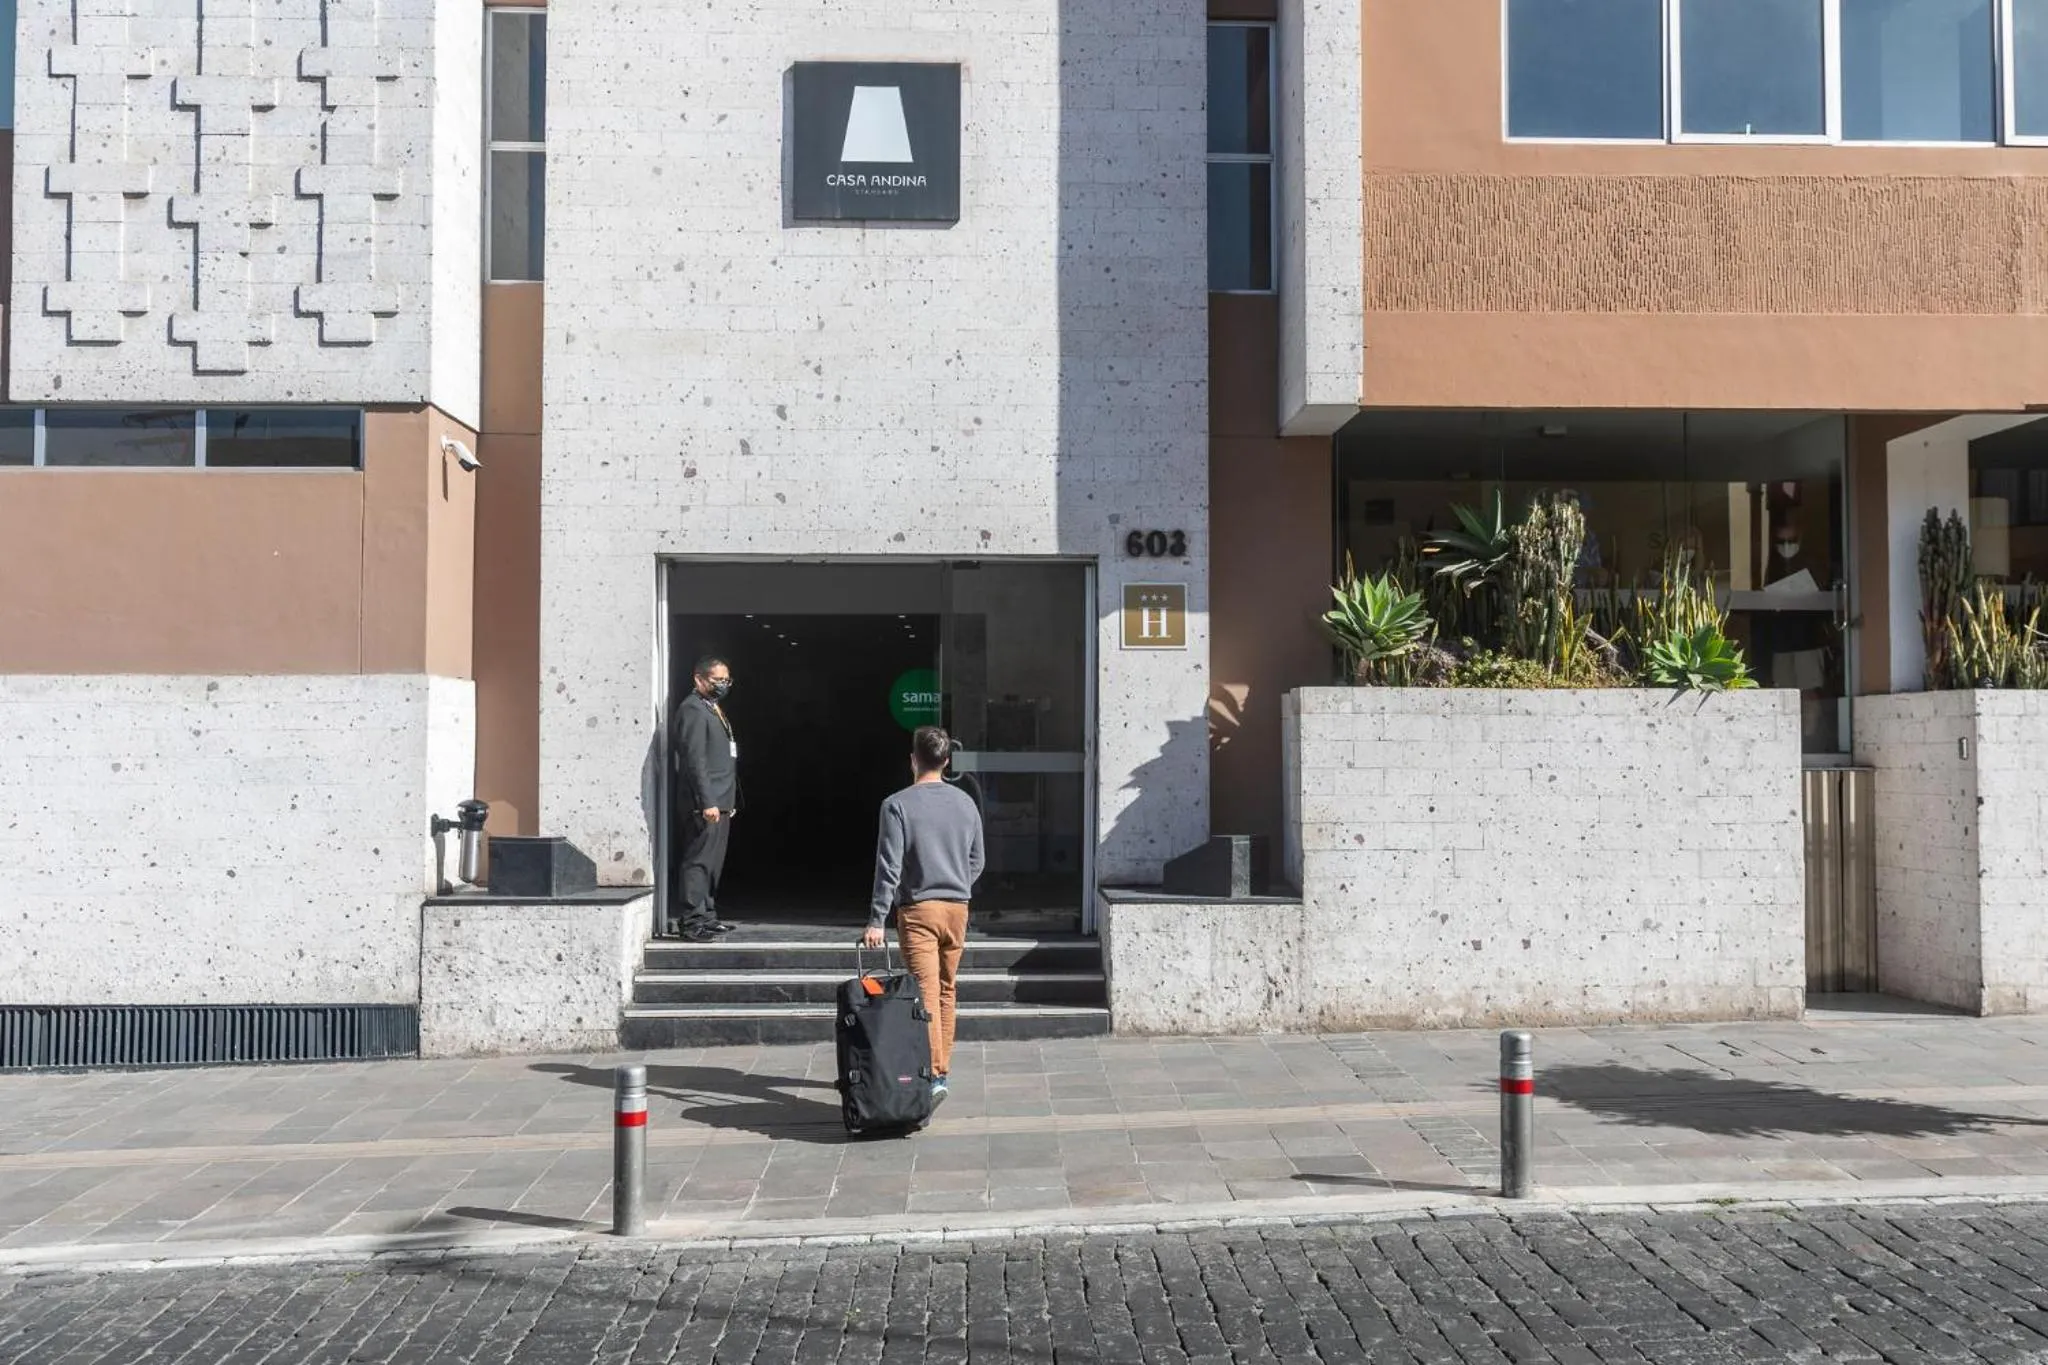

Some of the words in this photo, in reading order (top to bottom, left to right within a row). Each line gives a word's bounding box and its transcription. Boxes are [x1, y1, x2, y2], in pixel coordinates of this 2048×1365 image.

[826, 174, 866, 187] CASA
[871, 175, 927, 187] ANDINA
[1127, 529, 1187, 558] 603
[1138, 607, 1172, 638] H
[902, 692, 941, 703] sama
